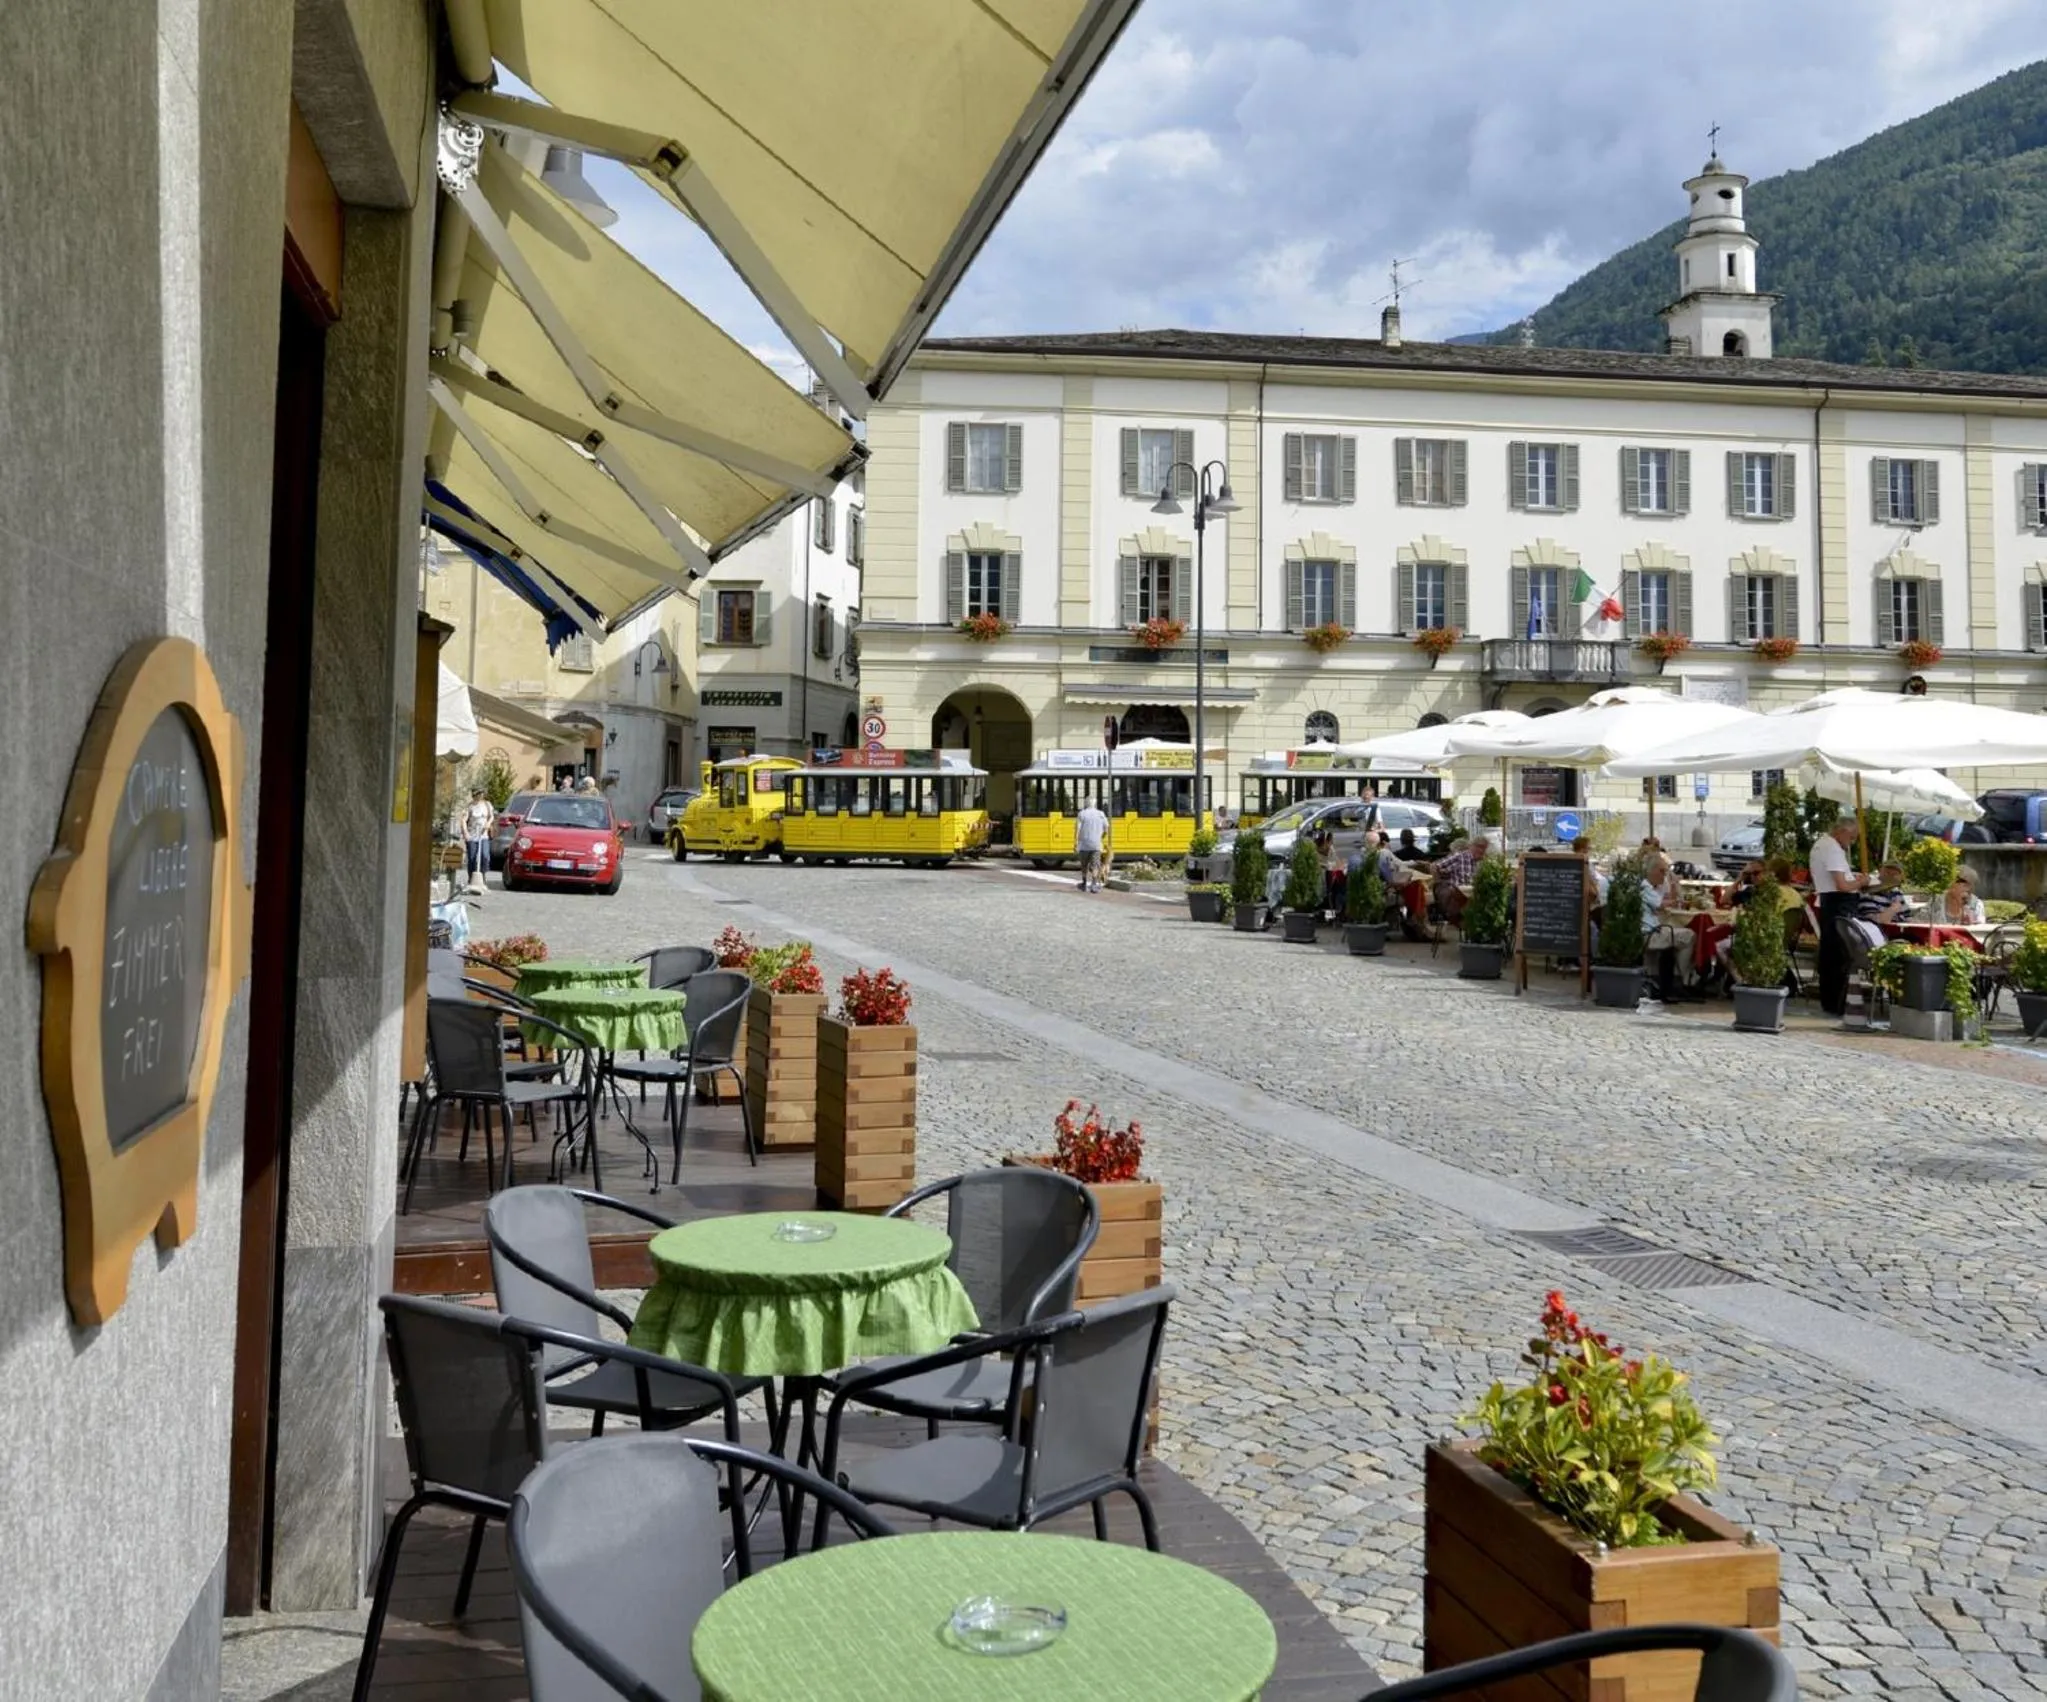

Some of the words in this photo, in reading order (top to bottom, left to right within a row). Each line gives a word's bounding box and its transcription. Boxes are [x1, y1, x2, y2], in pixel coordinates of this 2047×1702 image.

[867, 721, 880, 731] 30
[139, 841, 188, 893] LIBERE
[109, 913, 184, 1008] ZIMMER
[121, 1017, 164, 1082] FREI
